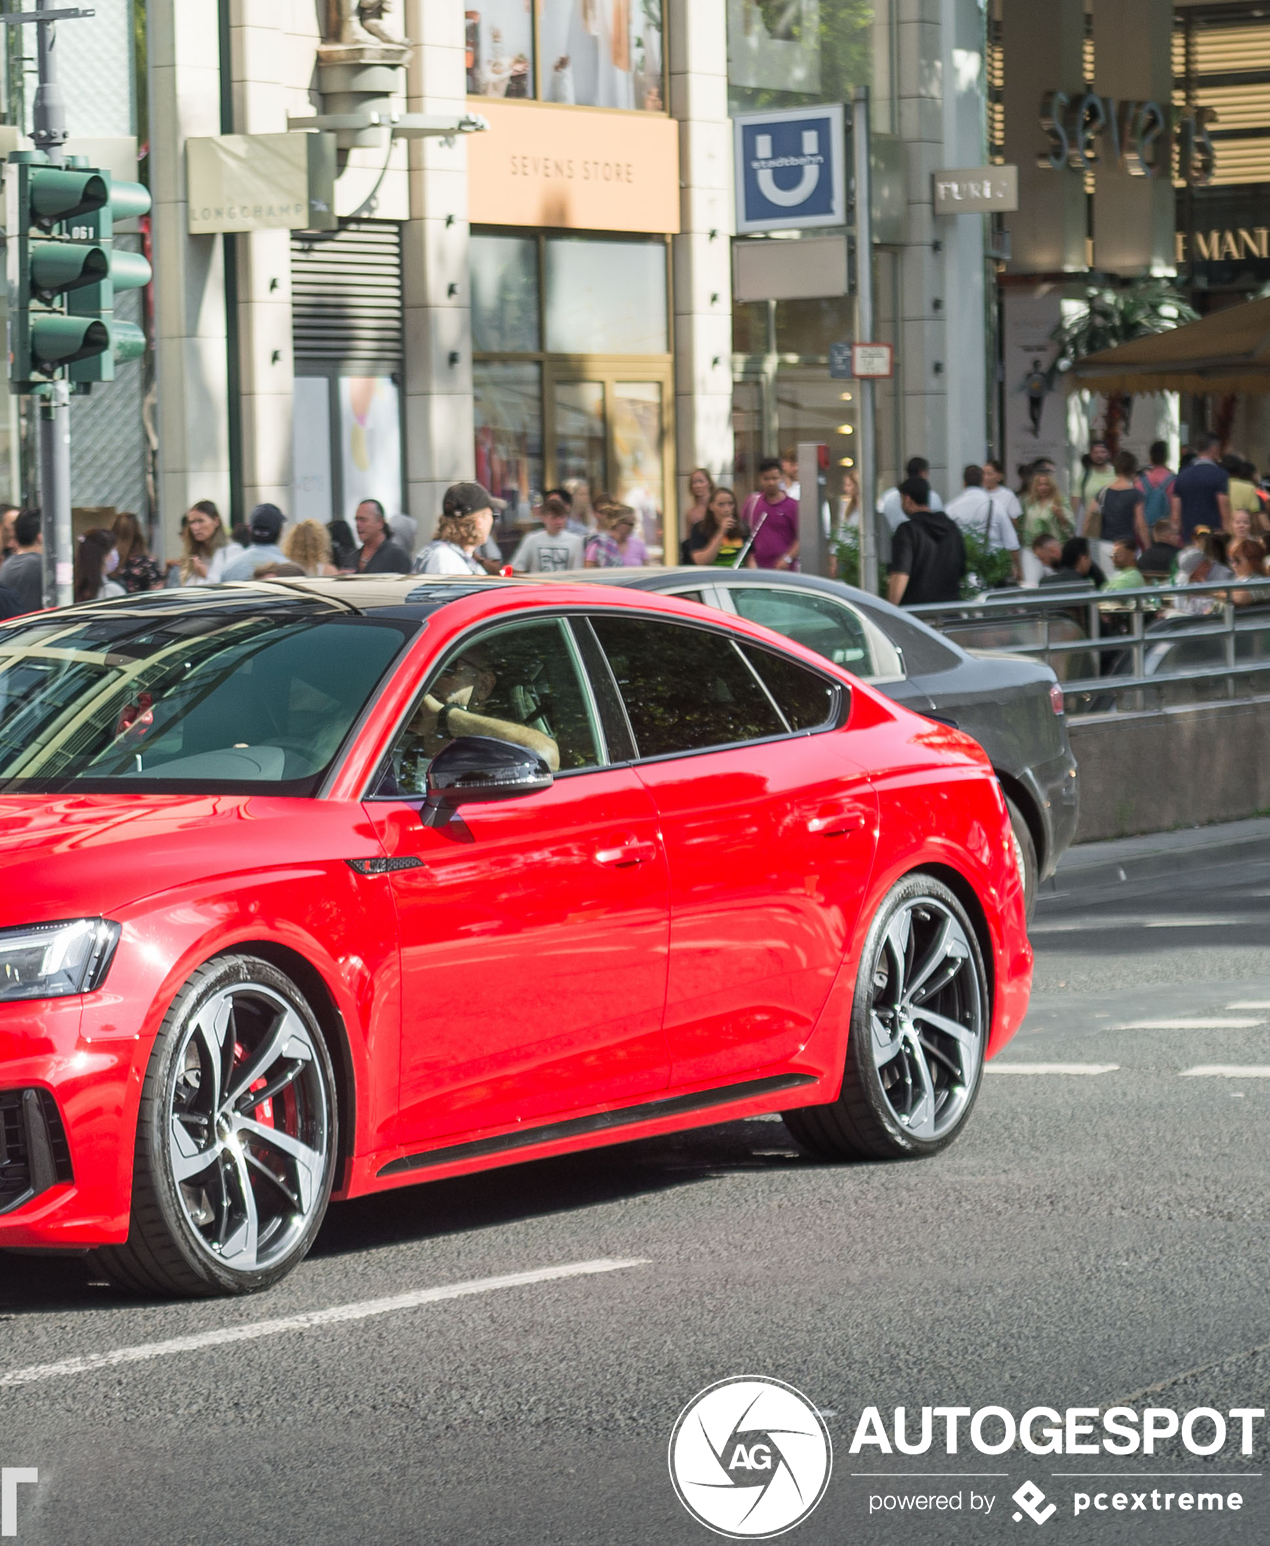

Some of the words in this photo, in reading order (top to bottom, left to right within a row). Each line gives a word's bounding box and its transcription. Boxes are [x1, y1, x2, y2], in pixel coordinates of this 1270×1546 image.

[510, 154, 574, 179] SEVENS
[582, 160, 633, 184] STORE
[190, 202, 304, 222] LONGCHAMP
